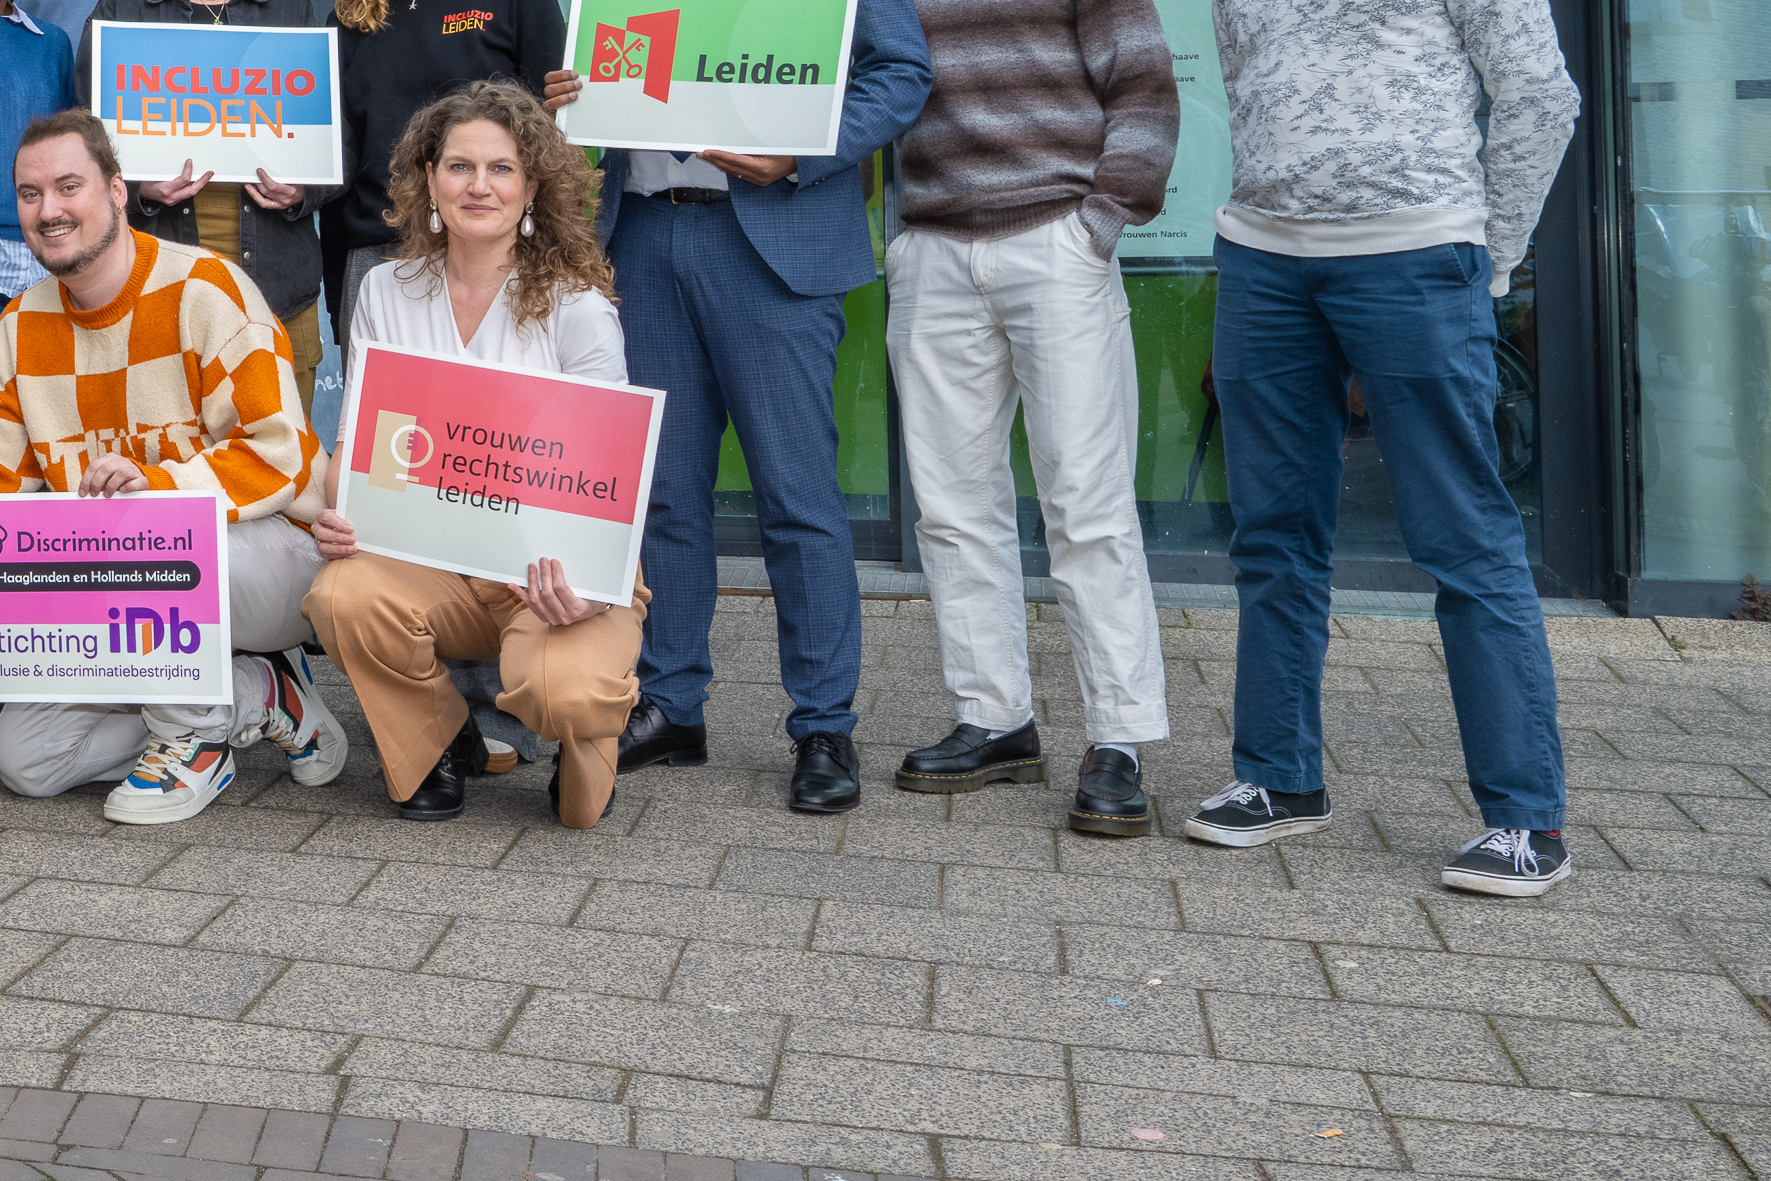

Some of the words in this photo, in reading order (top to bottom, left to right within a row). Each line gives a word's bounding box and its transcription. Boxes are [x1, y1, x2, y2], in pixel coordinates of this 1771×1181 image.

[443, 10, 494, 23] INCLUZIO
[116, 63, 316, 96] INCLUZIO
[696, 54, 820, 85] Leiden
[116, 96, 294, 138] LEIDEN.
[1160, 230, 1188, 238] Narcis
[446, 421, 564, 460] vrouwen
[441, 450, 618, 502] rechtswinkel
[436, 476, 520, 515] leiden
[17, 529, 193, 553] Discriminatie.nl
[73, 573, 88, 583] en
[91, 570, 143, 583] Hollands
[145, 570, 191, 582] Midden
[33, 665, 44, 677] &
[46, 664, 200, 680] discriminatiebestrijding
